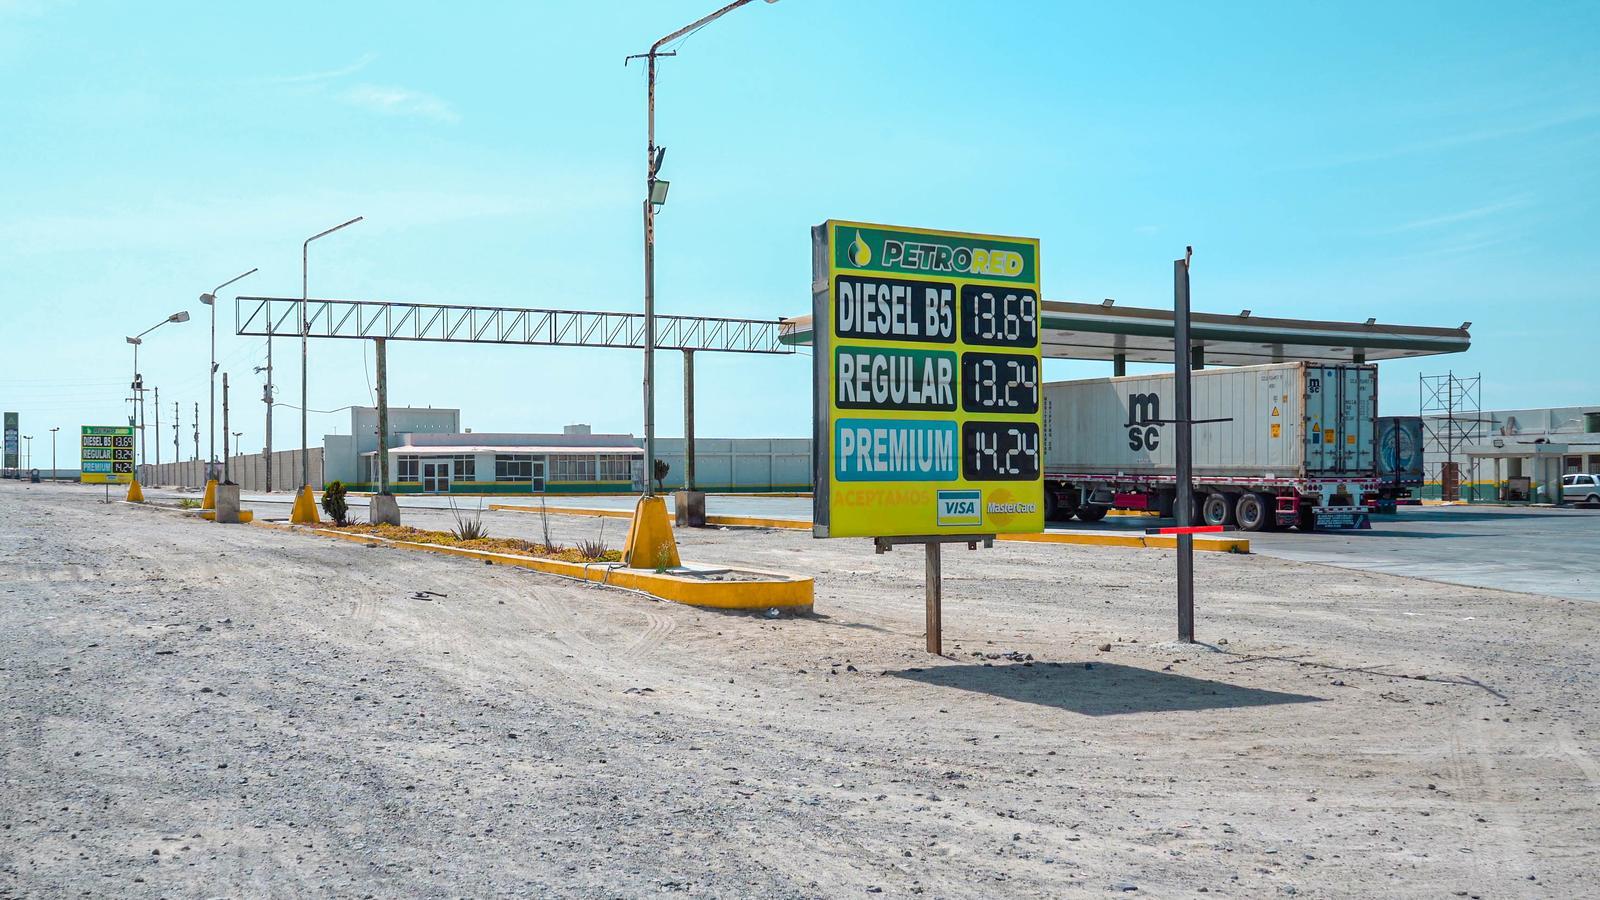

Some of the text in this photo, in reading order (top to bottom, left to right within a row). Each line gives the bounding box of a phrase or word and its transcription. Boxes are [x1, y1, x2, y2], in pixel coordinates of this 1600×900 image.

[881, 240, 1024, 276] PETRORED
[839, 281, 952, 338] DIESEL B5
[974, 292, 1037, 340] 13.69
[839, 353, 954, 405] REGULAR
[975, 359, 1037, 407] 13.24
[83, 436, 111, 446] DIESEL B5
[83, 450, 111, 459] REGULAR
[840, 428, 954, 473] PREMIUM
[976, 429, 1038, 475] 14.24
[834, 489, 930, 507] ACEPTAMOS
[944, 501, 975, 514] VISA
[986, 501, 1036, 514] MasterCard
